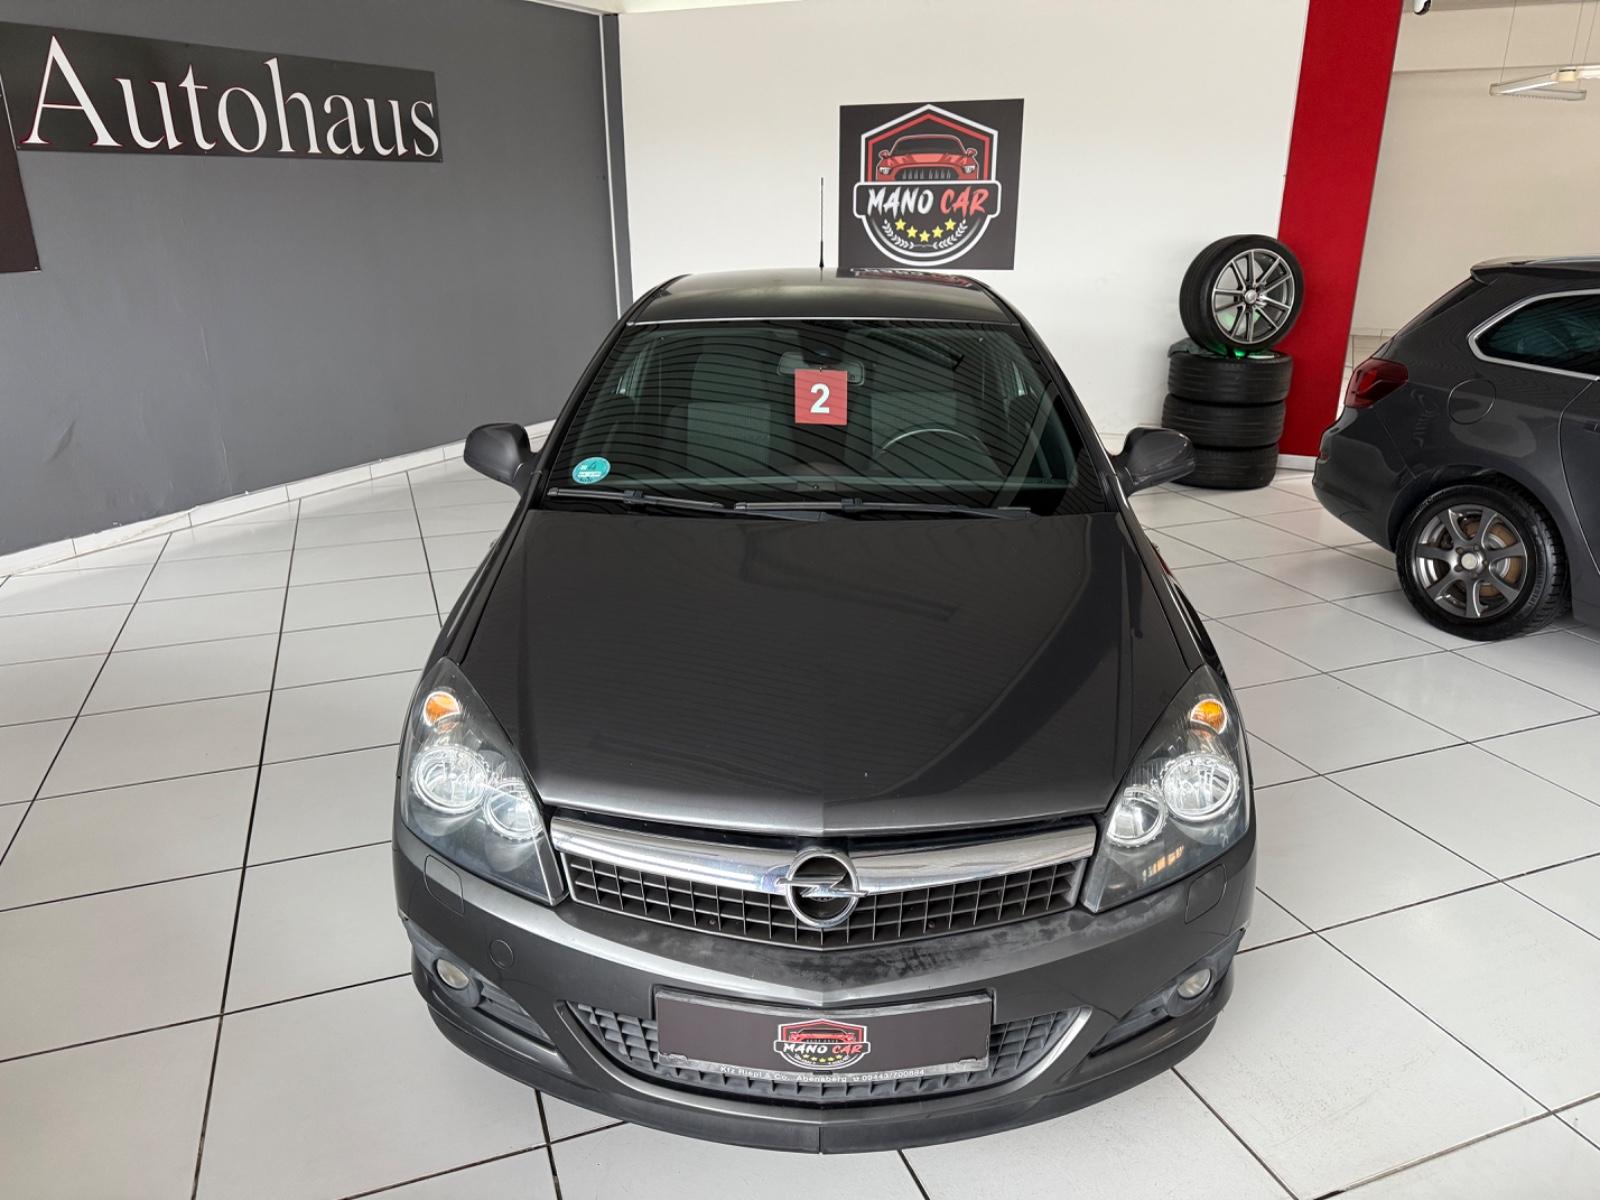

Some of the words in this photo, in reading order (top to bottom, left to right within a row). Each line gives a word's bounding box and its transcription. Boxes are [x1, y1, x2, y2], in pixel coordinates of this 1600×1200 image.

[21, 35, 440, 158] Autohaus
[867, 186, 934, 219] MANO
[940, 186, 989, 217] CAR
[810, 383, 830, 414] 2
[783, 1043, 828, 1054] MANO
[832, 1044, 863, 1055] CAR
